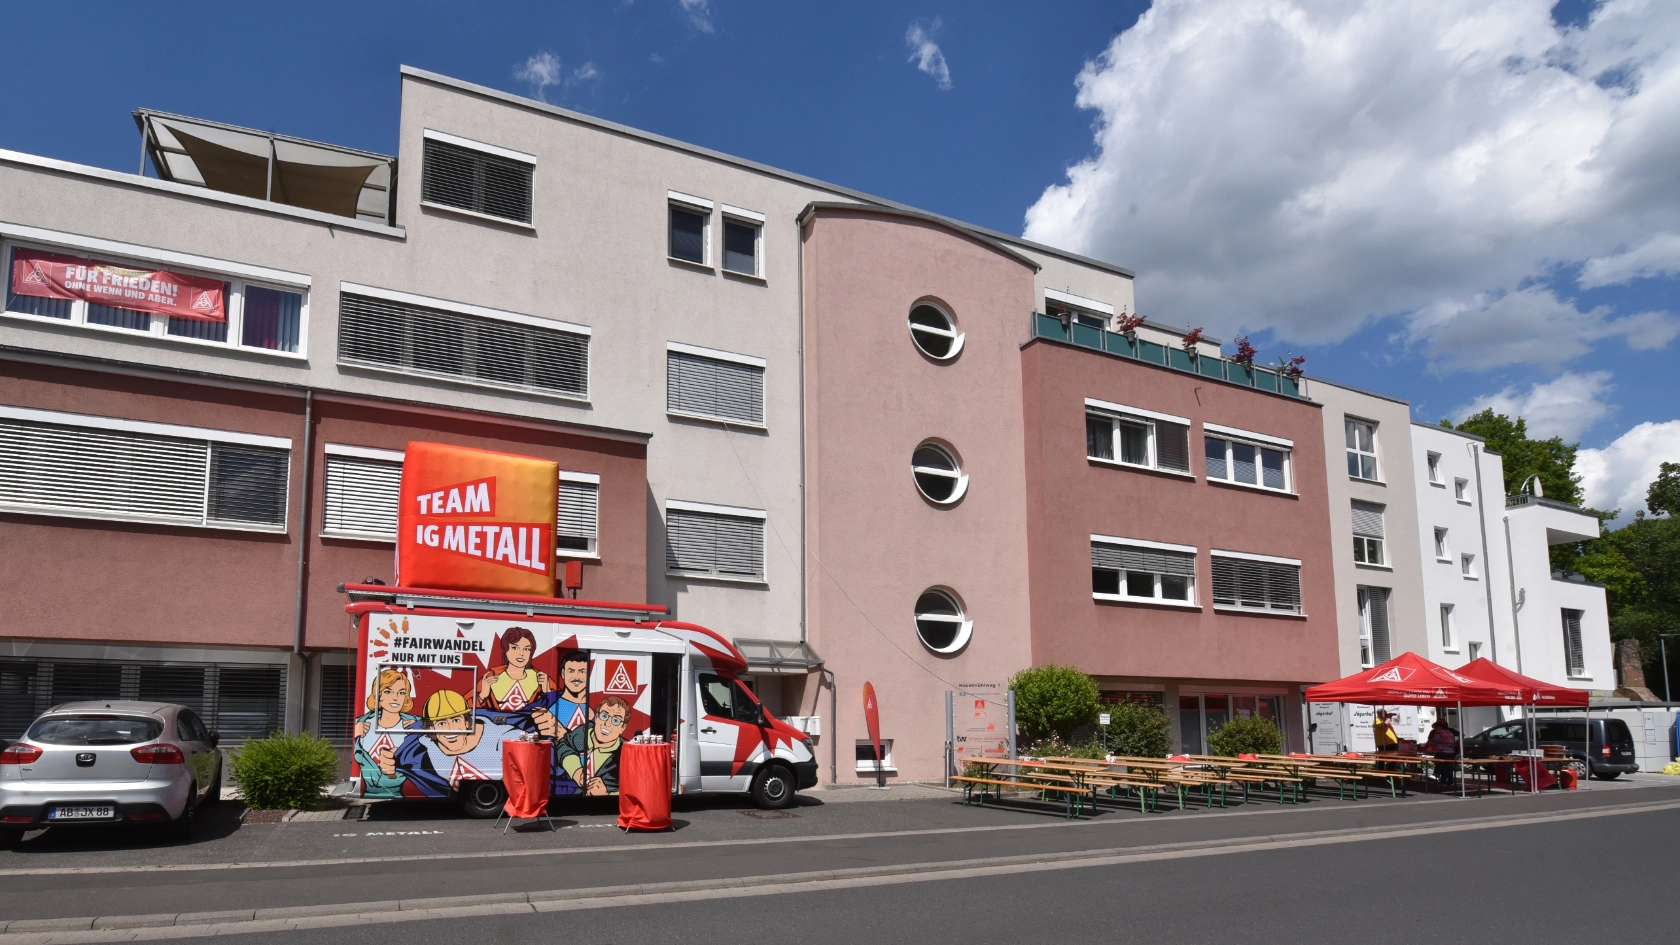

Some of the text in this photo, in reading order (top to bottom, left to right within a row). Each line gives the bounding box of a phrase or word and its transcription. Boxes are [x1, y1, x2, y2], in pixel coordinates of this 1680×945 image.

[64, 281, 91, 292] OHNE
[94, 285, 122, 296] WENN
[124, 289, 145, 300] UND
[147, 294, 177, 306] ABER.
[65, 265, 98, 283] FÜR
[102, 273, 178, 297] FRIEDEN!
[416, 482, 491, 515] TEAM
[416, 524, 546, 571] IG METALL
[393, 637, 486, 652] #FAIRWANDEL
[391, 652, 461, 664] NUR MIT UNS
[59, 807, 109, 817] AB JX 88
